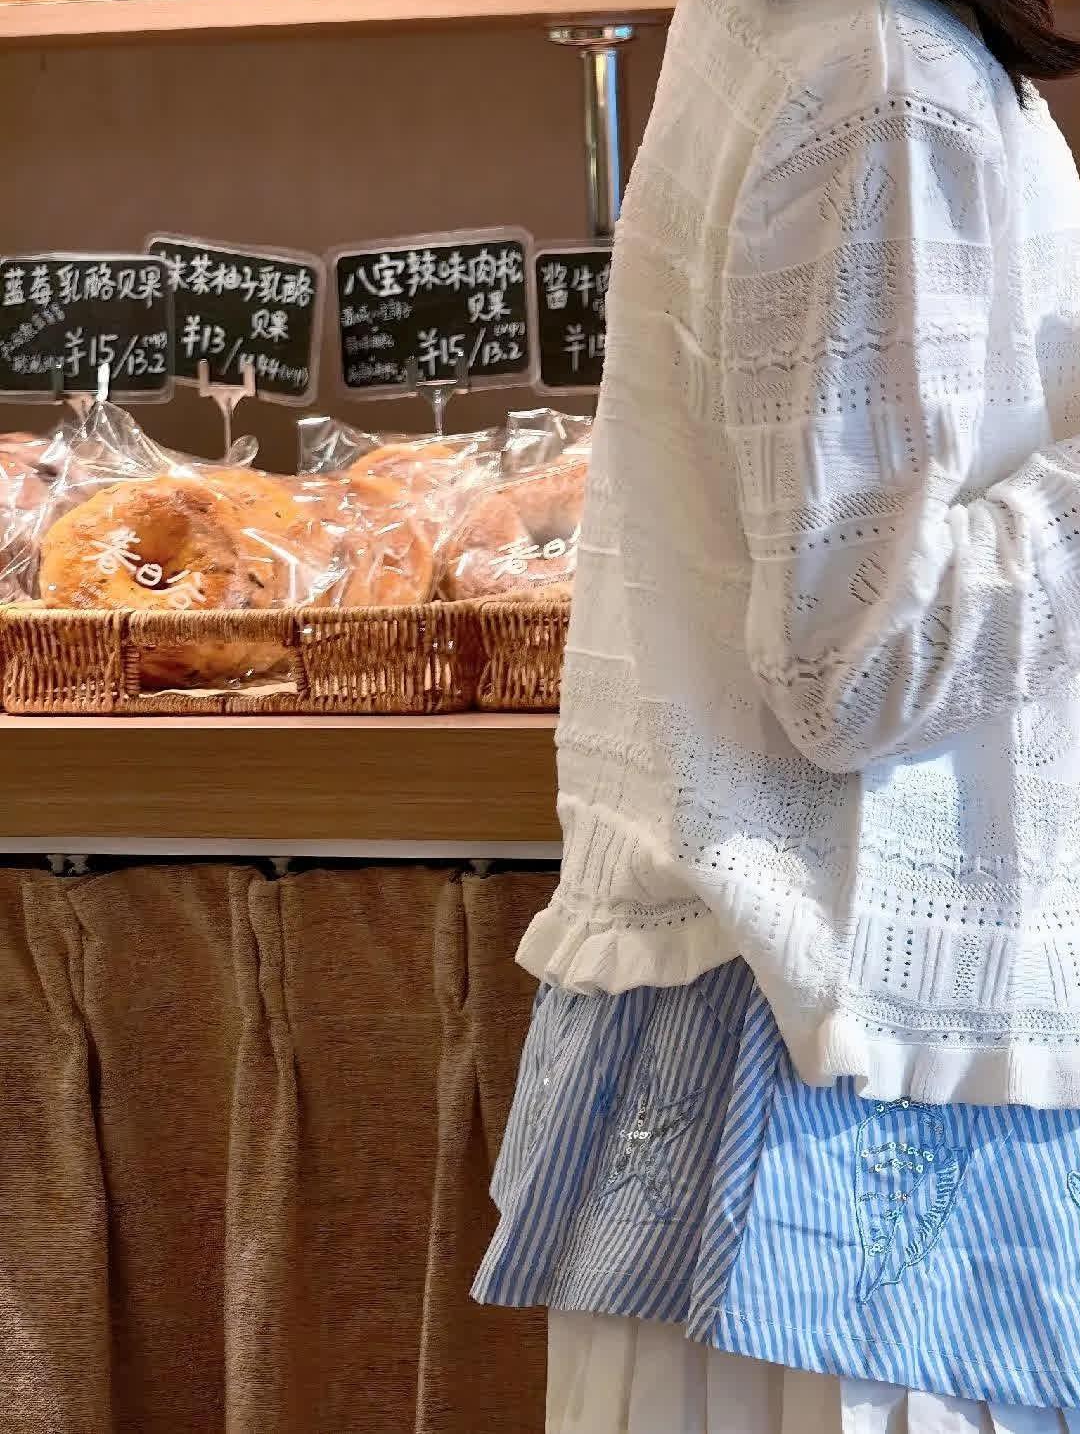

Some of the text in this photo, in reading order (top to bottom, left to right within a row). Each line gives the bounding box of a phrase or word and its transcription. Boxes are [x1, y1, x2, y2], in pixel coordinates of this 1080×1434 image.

[2, 261, 164, 308] 蓝莓乳酪贝果
[343, 246, 523, 297] 八宝辣味肉松
